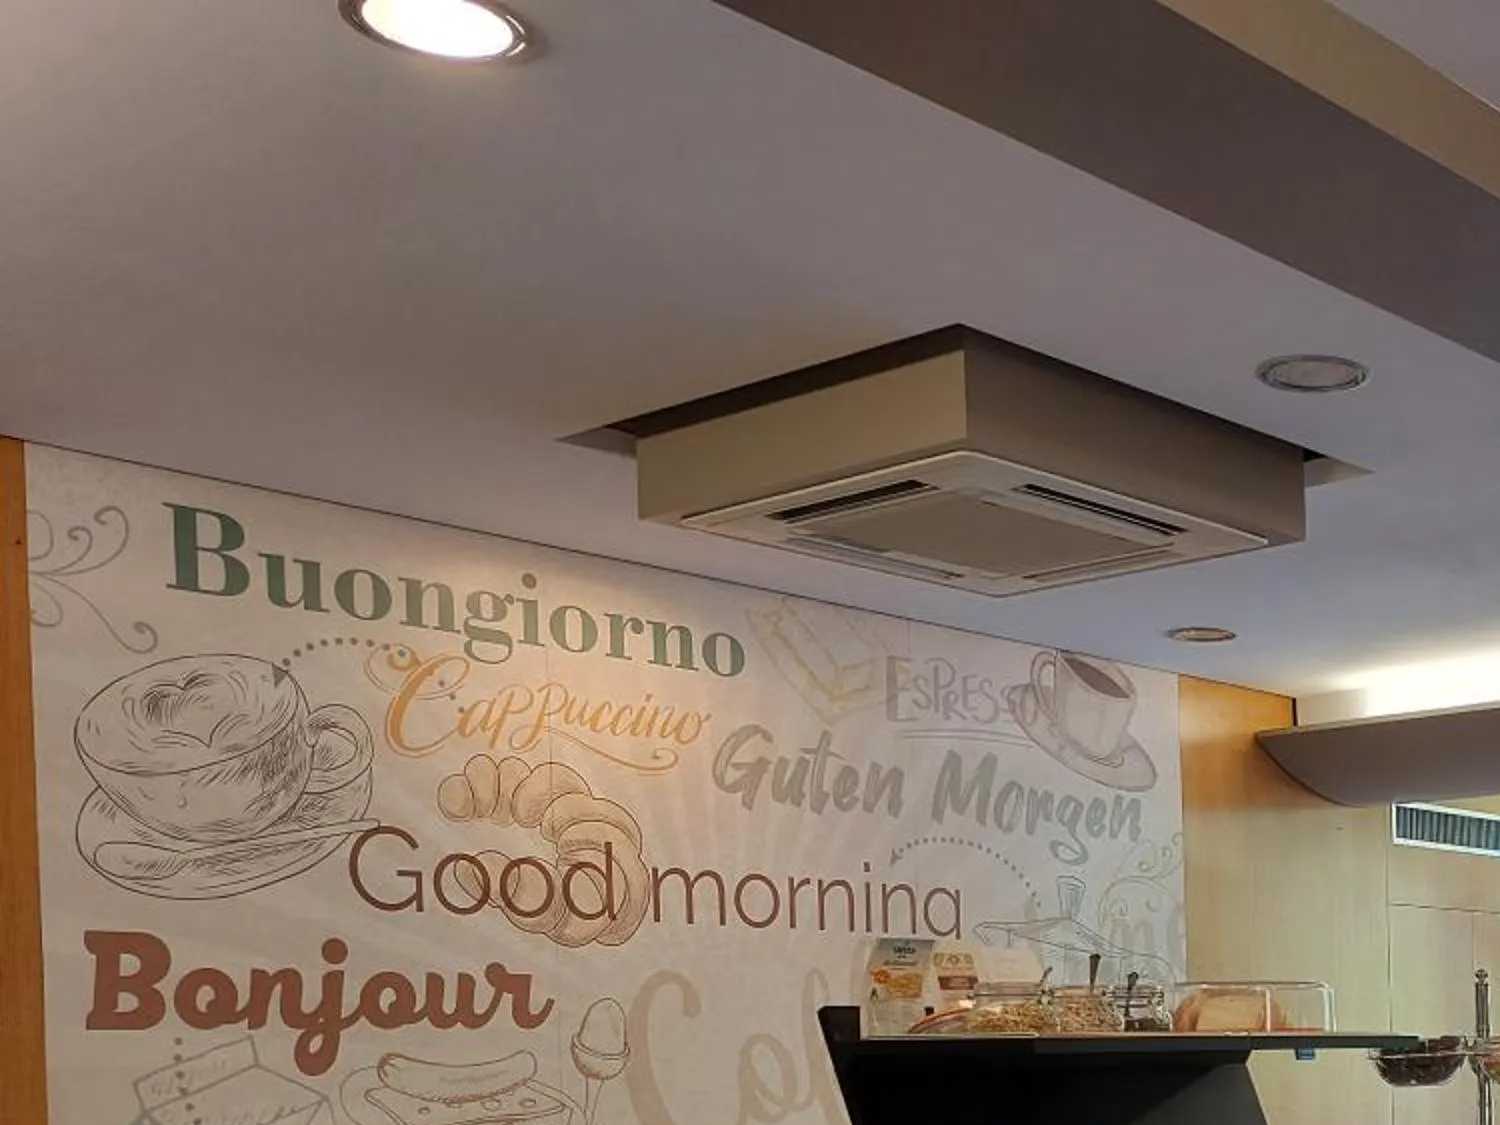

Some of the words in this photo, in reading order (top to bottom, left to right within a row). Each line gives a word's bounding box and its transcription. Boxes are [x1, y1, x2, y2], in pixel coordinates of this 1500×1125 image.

[162, 501, 746, 678] Buongiorno
[711, 724, 905, 817] Guten
[930, 750, 1142, 865] Morgen
[348, 825, 616, 922] Good
[83, 929, 556, 1077] Bonjour
